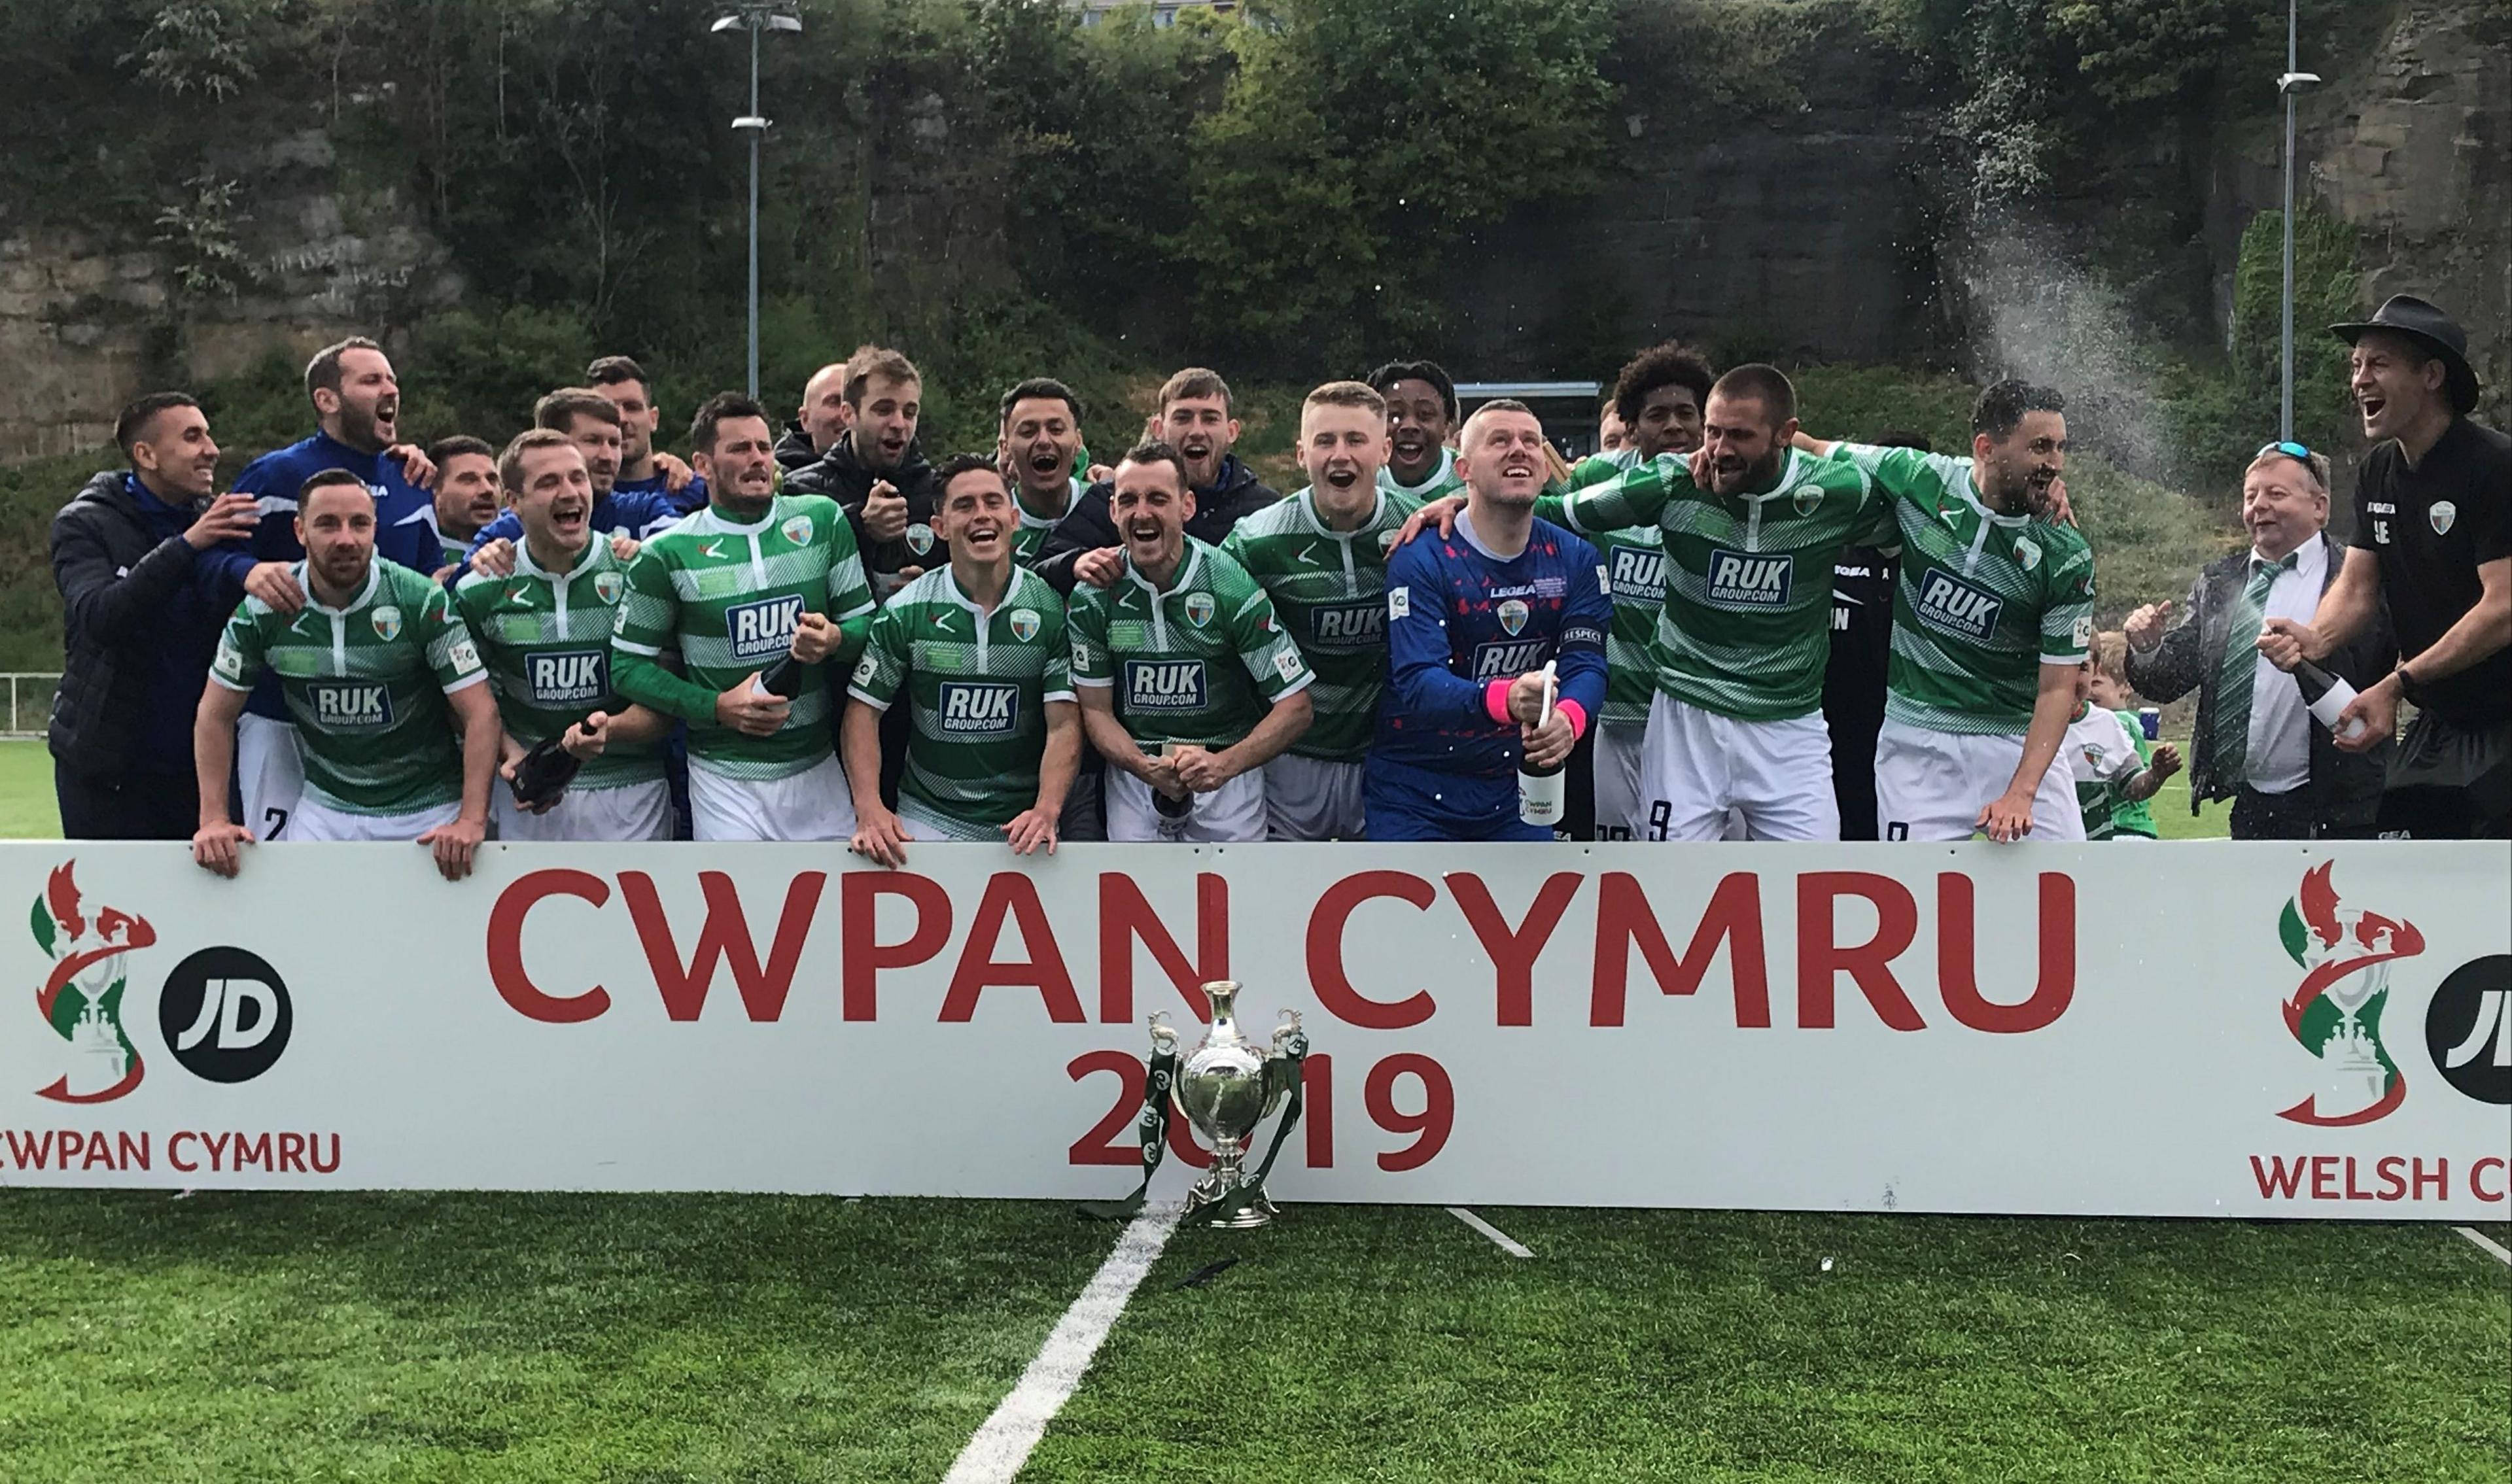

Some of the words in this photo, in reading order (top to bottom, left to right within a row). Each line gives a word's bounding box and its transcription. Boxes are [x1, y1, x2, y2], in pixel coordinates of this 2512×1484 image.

[1714, 556, 1789, 590] RUK
[1490, 584, 1536, 598] LEGEA
[1711, 587, 1779, 602] GROUP.COM
[1924, 578, 1999, 627] RUK
[737, 599, 800, 642] RUK
[1319, 608, 1387, 636] RUK
[1919, 602, 1985, 635] GROUP.COM
[1564, 630, 1601, 642] RESPECT
[536, 655, 601, 688] RUK
[1478, 641, 1548, 676] RUK
[536, 686, 598, 700] GROUP.COM
[1134, 664, 1202, 694] RUK
[319, 687, 383, 714] RUK
[946, 688, 1017, 718] RUK
[1134, 693, 1196, 706] GROUP.COM
[944, 717, 1007, 730] GROUP.COM
[1649, 800, 1672, 842] 9
[487, 868, 1229, 1024] CWPAN
[1306, 869, 2076, 1033] CYMRU
[177, 978, 279, 1052] JD
[2445, 990, 2512, 1069] J
[0, 1130, 150, 1171] WPAN
[168, 1131, 341, 1173] CYMRU
[2249, 1156, 2449, 1201] WELSH
[2469, 1157, 2512, 1202] C
